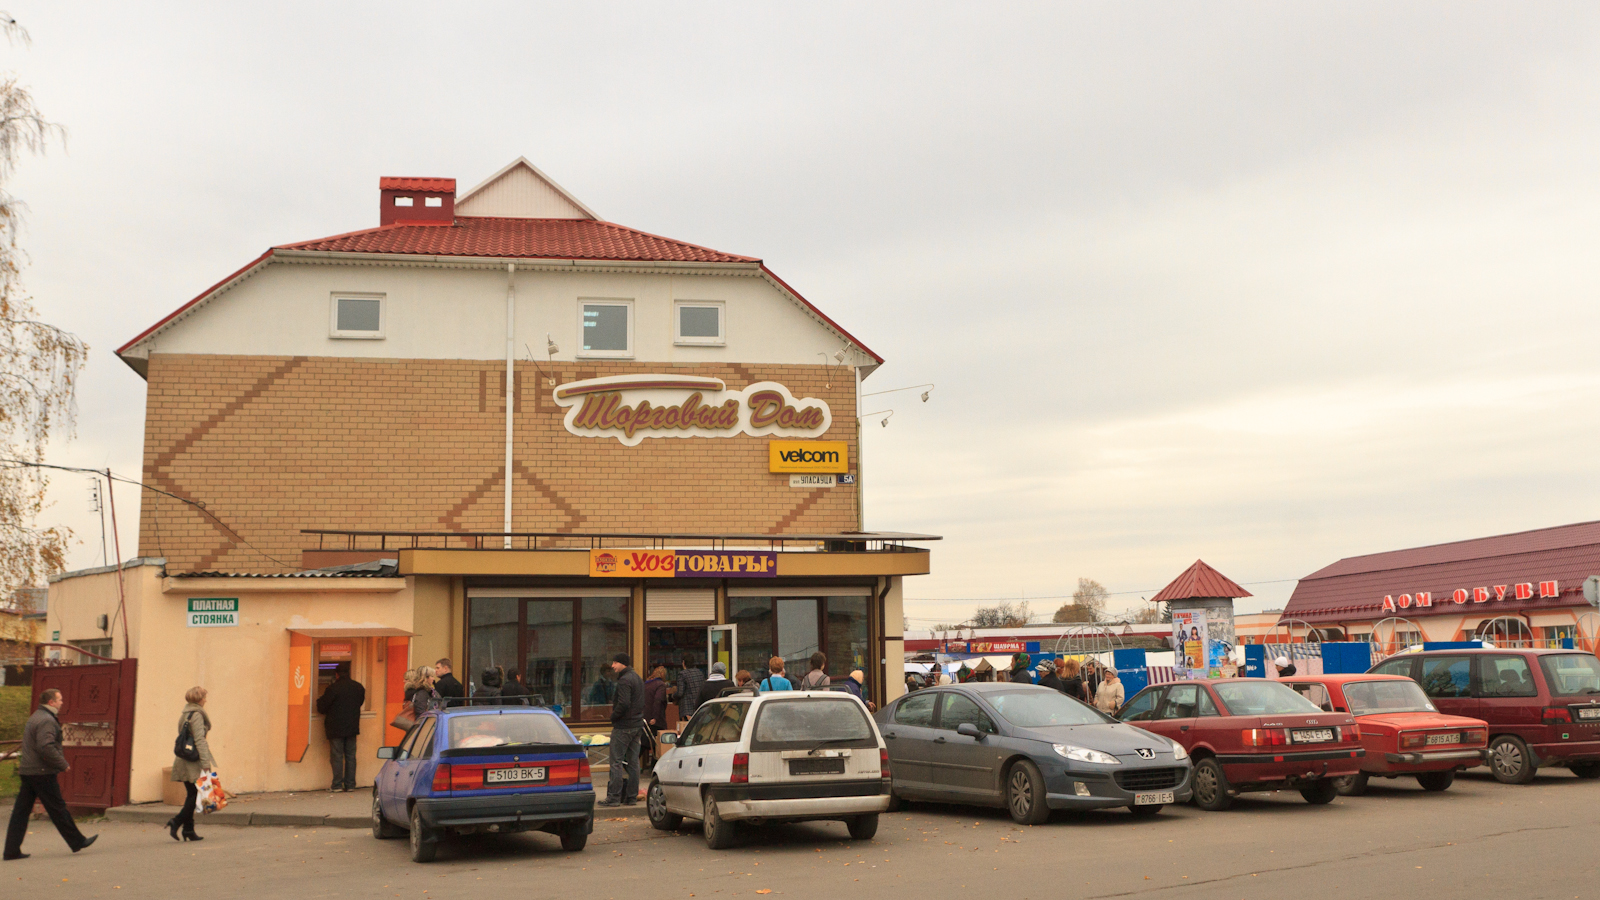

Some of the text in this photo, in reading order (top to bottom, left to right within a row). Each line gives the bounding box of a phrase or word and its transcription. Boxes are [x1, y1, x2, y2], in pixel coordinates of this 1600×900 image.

[557, 380, 825, 438] Торговый Дом
[779, 448, 839, 463] velcom
[1382, 580, 1560, 613] ДОМ ОБУВИ
[192, 600, 235, 611] ПЛАТНАЯ
[192, 614, 234, 625] СТОЯНКА
[497, 768, 543, 780] 5103 BK-5
